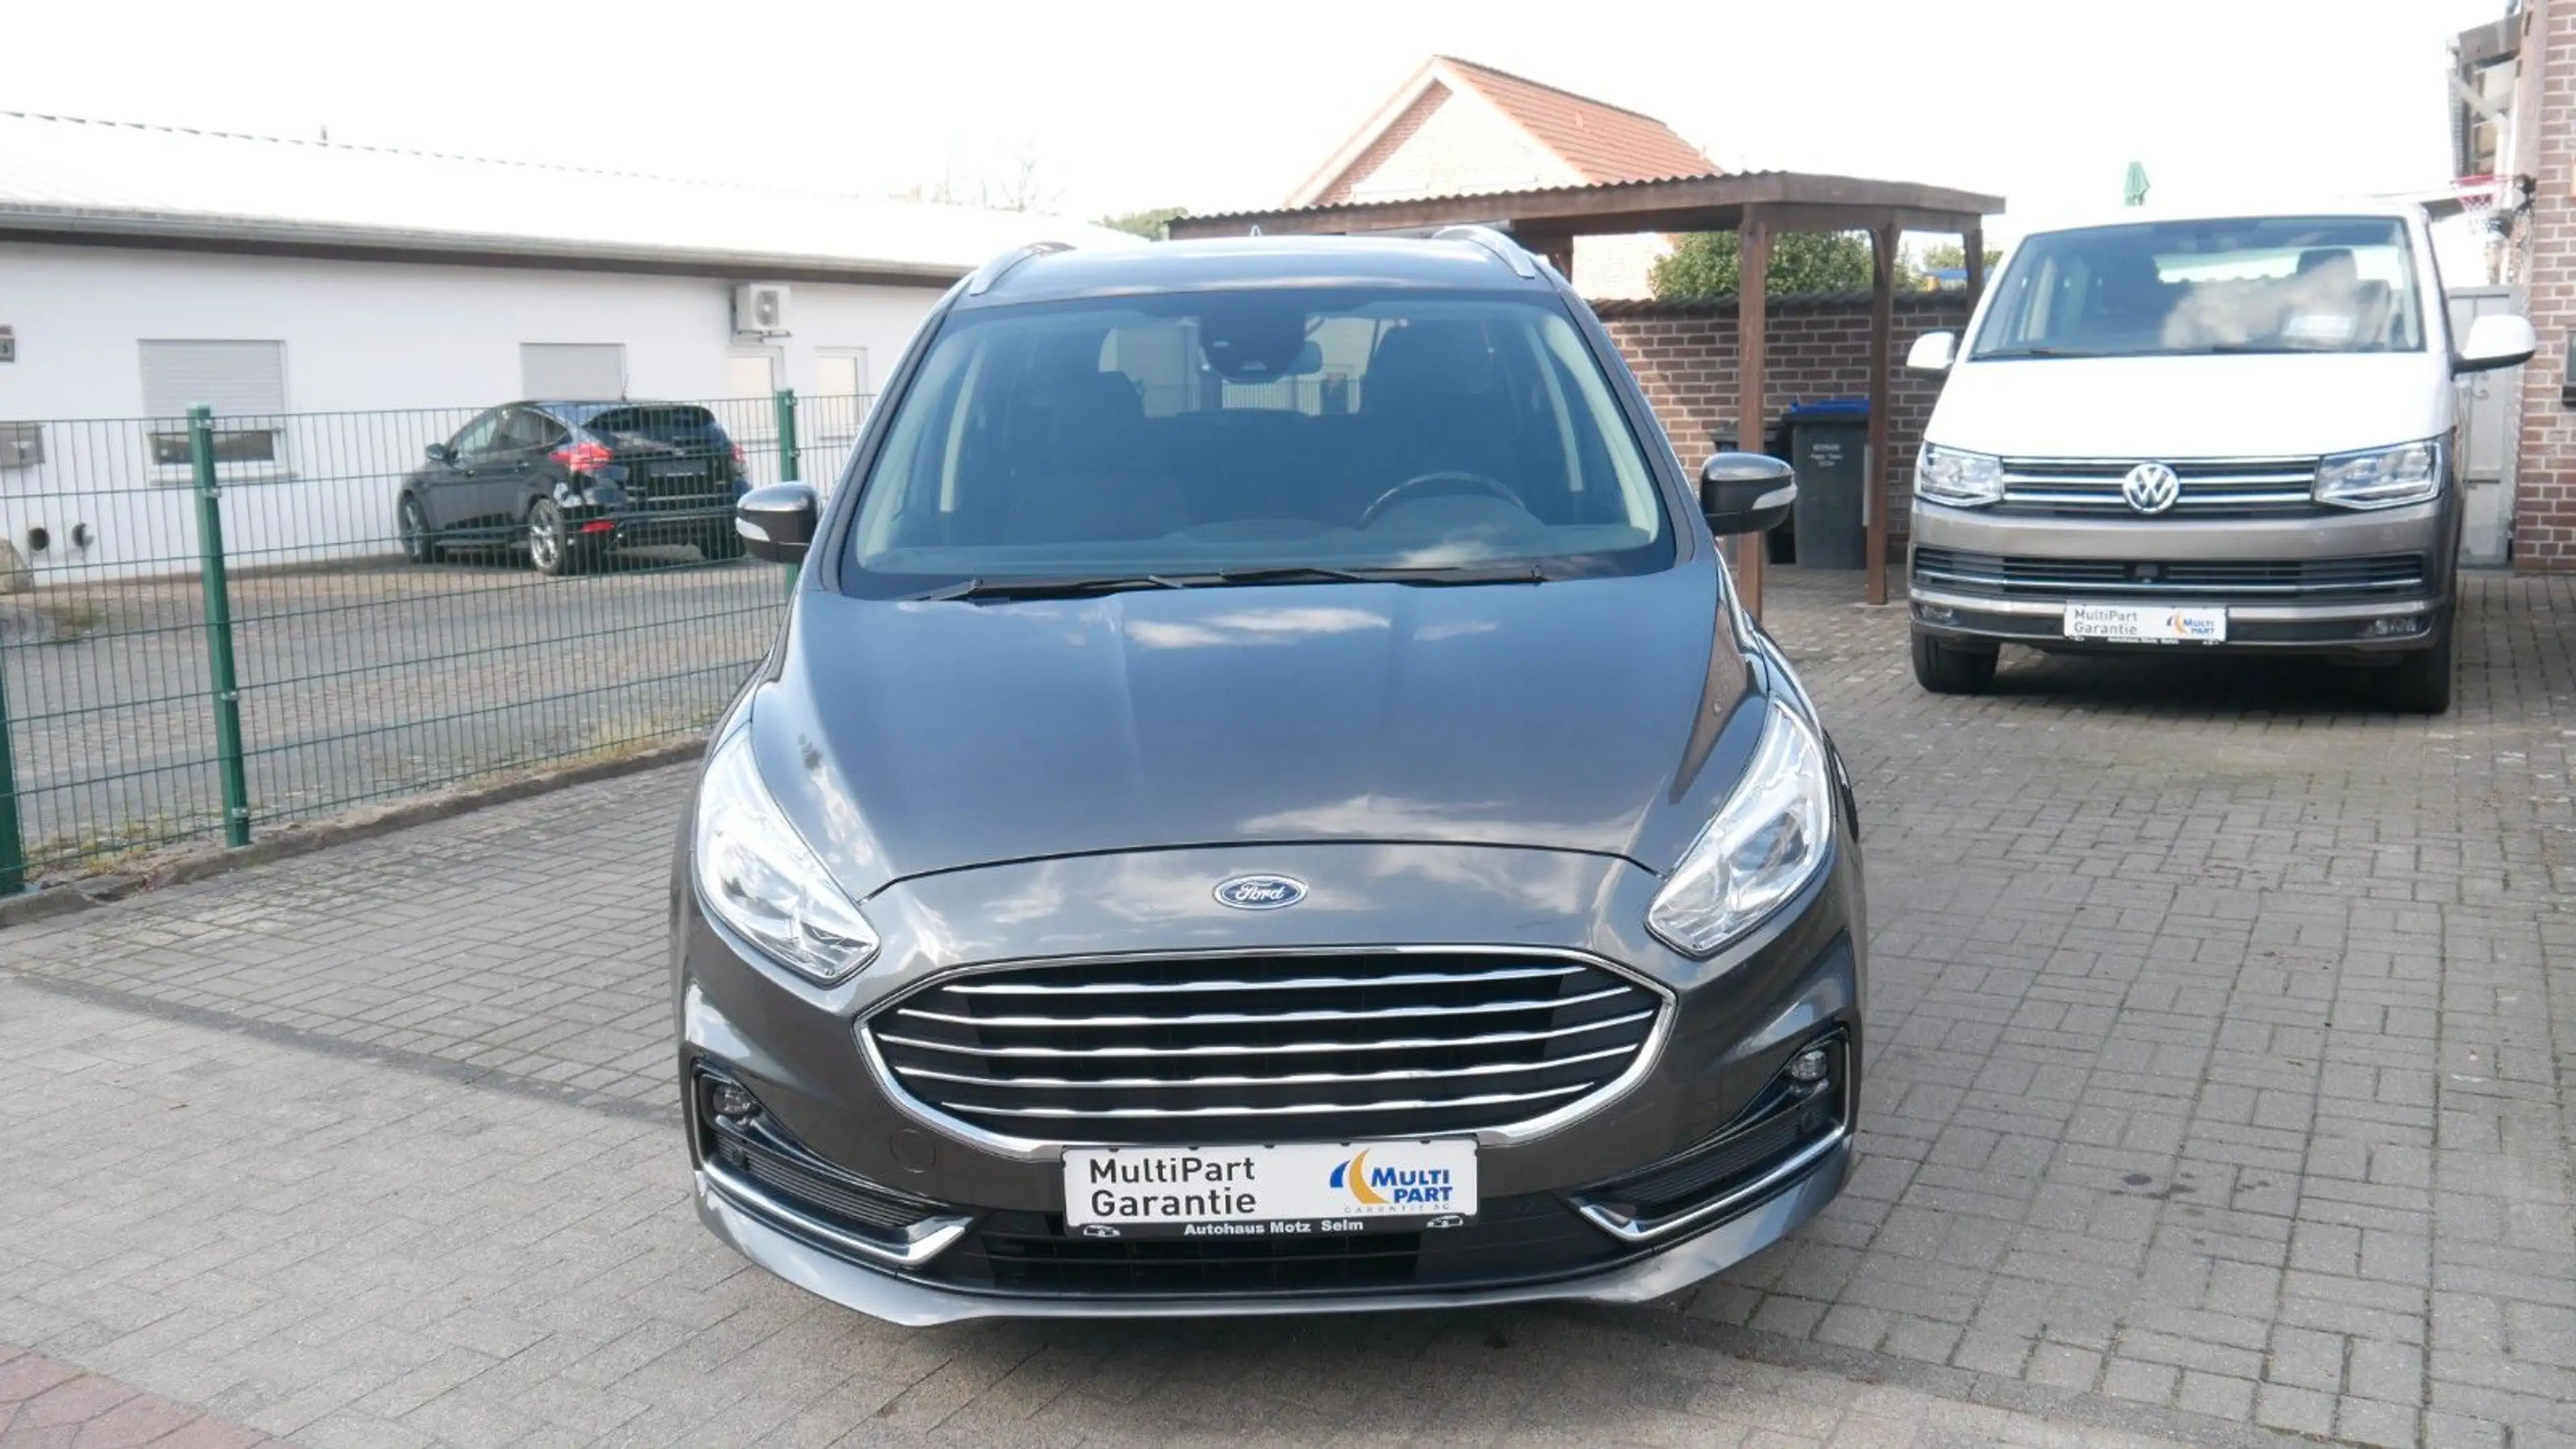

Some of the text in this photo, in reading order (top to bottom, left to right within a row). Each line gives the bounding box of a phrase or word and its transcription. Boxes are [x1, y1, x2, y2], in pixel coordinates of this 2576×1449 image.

[2074, 608, 2137, 622] MultiPart
[2074, 621, 2137, 635] Garantie
[1234, 881, 1286, 901] Ford
[1089, 1157, 1255, 1184] MultiPart
[1371, 1167, 1450, 1187] MULTI
[1091, 1187, 1256, 1216] Garantie
[1393, 1186, 1453, 1203] PART
[1183, 1220, 1364, 1236] Autohaus Motz Selm
